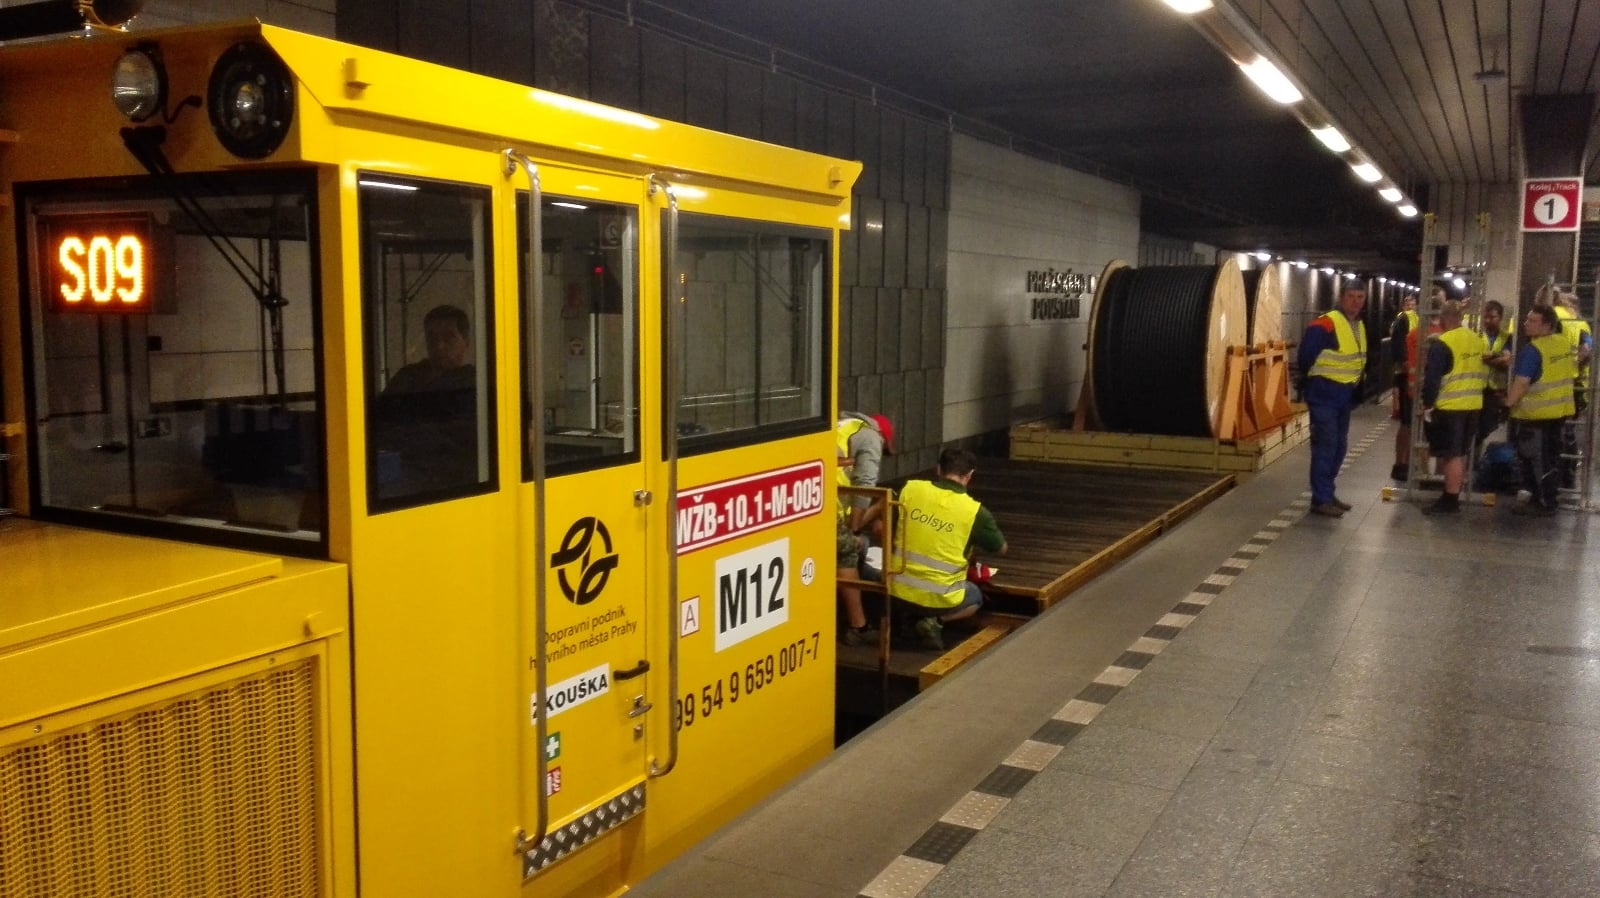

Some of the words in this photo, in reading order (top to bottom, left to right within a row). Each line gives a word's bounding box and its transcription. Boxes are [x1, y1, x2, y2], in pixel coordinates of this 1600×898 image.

[1543, 198, 1555, 219] 1
[59, 236, 143, 302] S09
[910, 508, 955, 532] Colsys
[801, 562, 813, 580] 40
[720, 557, 784, 633] M12
[591, 605, 626, 629] podnik
[684, 604, 696, 630] A
[529, 643, 577, 669] hvního
[580, 632, 608, 651] města
[611, 621, 637, 638] Prahy
[702, 680, 724, 717] 54
[730, 672, 739, 703] 9
[746, 655, 774, 694] 659
[780, 632, 820, 677] 007-7
